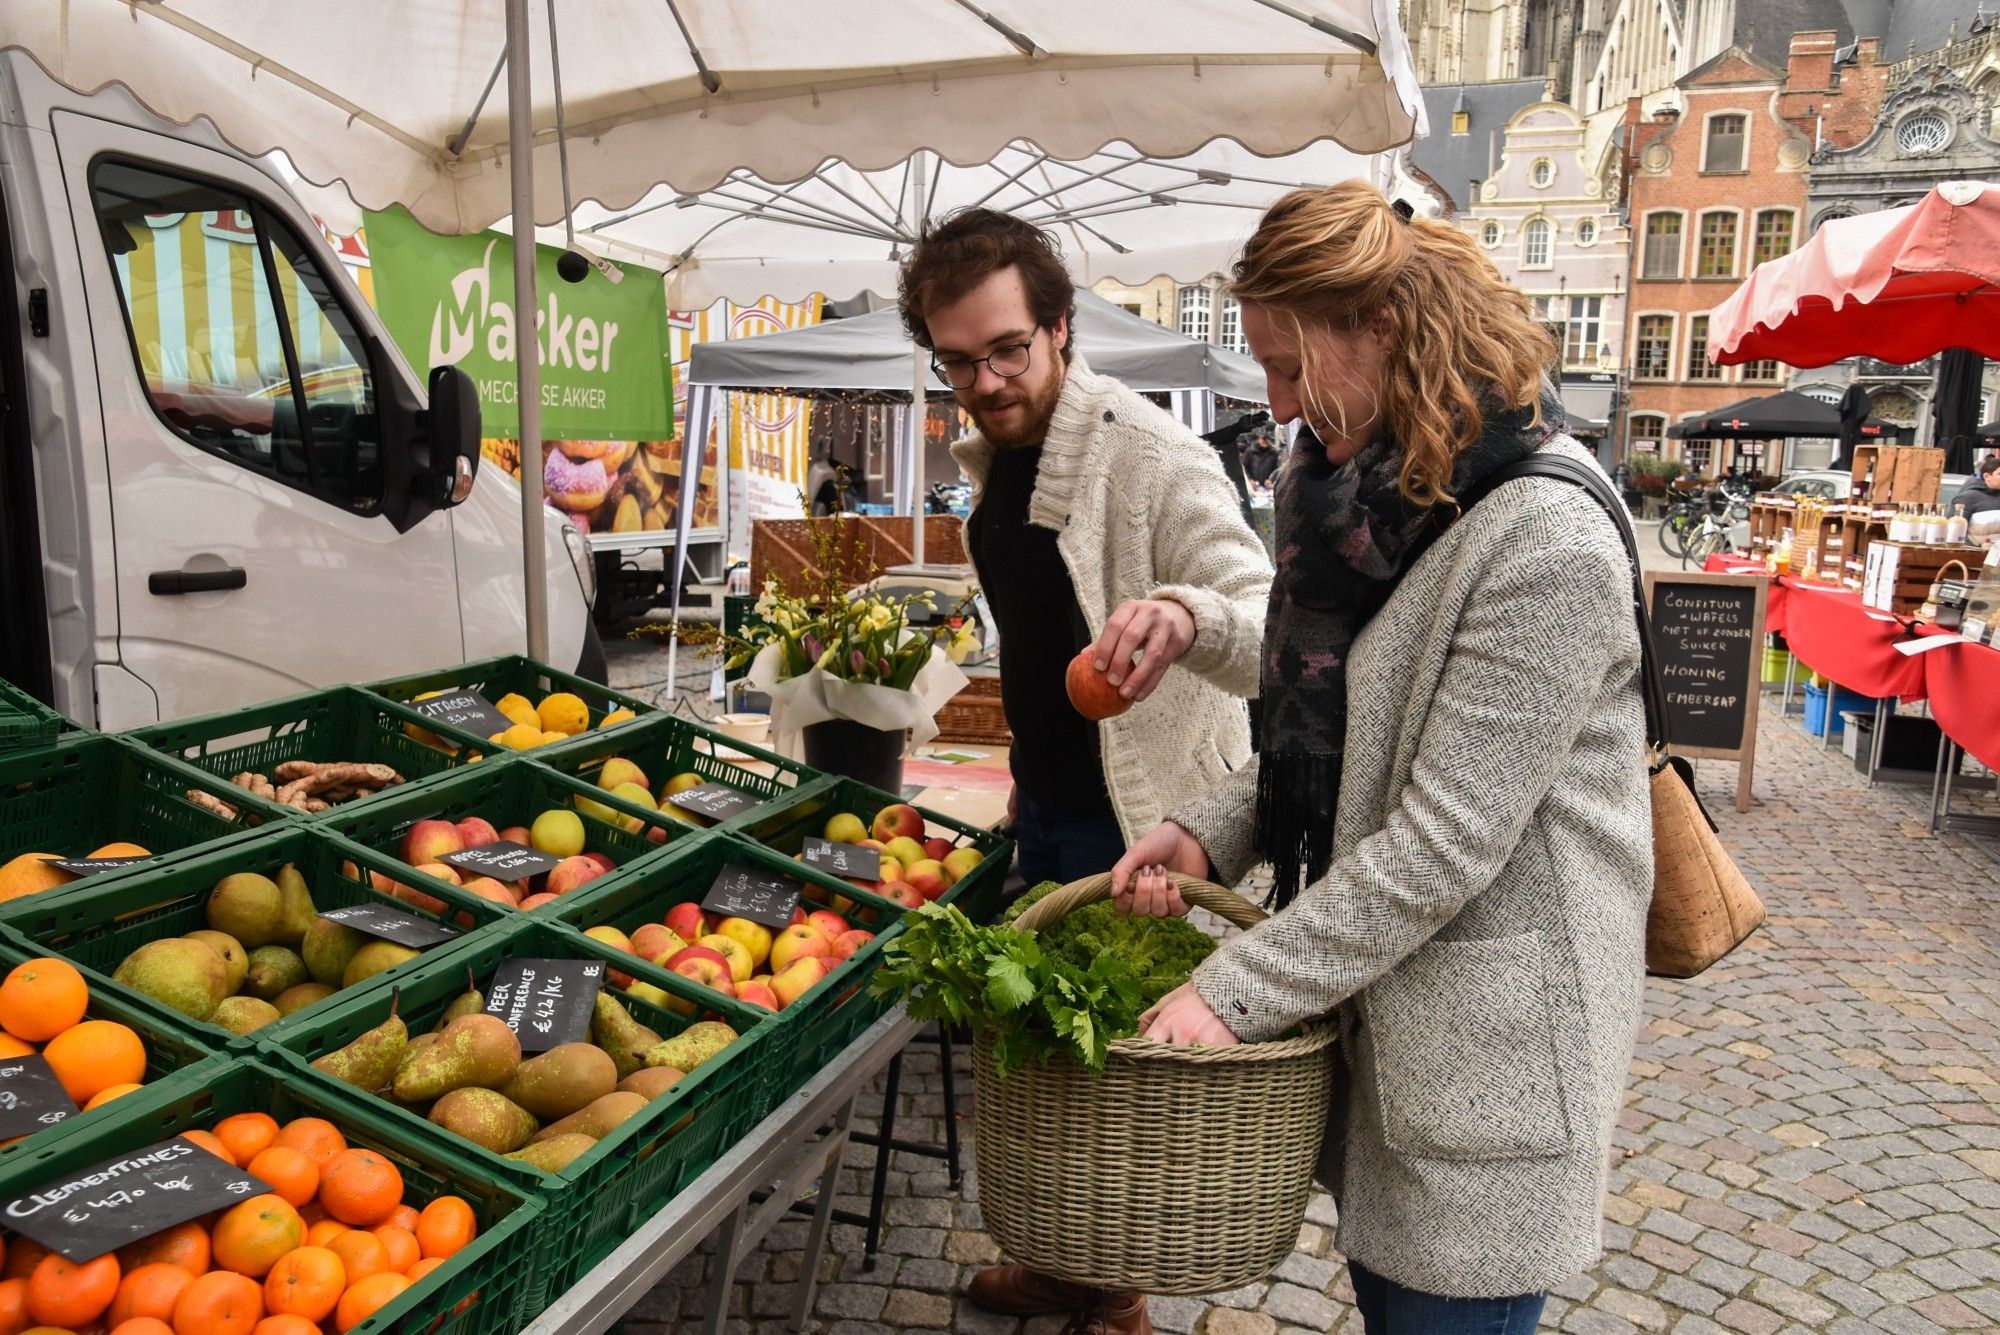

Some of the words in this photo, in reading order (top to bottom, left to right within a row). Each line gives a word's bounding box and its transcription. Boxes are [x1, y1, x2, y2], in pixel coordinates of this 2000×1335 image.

[562, 387, 606, 409] AKKER
[1665, 591, 1741, 609] CONFITUUR
[1690, 611, 1738, 623] WAFELS
[1662, 625, 1690, 634] MET
[1697, 628, 1710, 636] OF
[1713, 628, 1751, 638] ZONDER
[1680, 639, 1727, 651] SUIKER
[1663, 664, 1726, 681] HONING
[1667, 692, 1737, 708] EMBERSAP
[487, 983, 512, 1012] PEER
